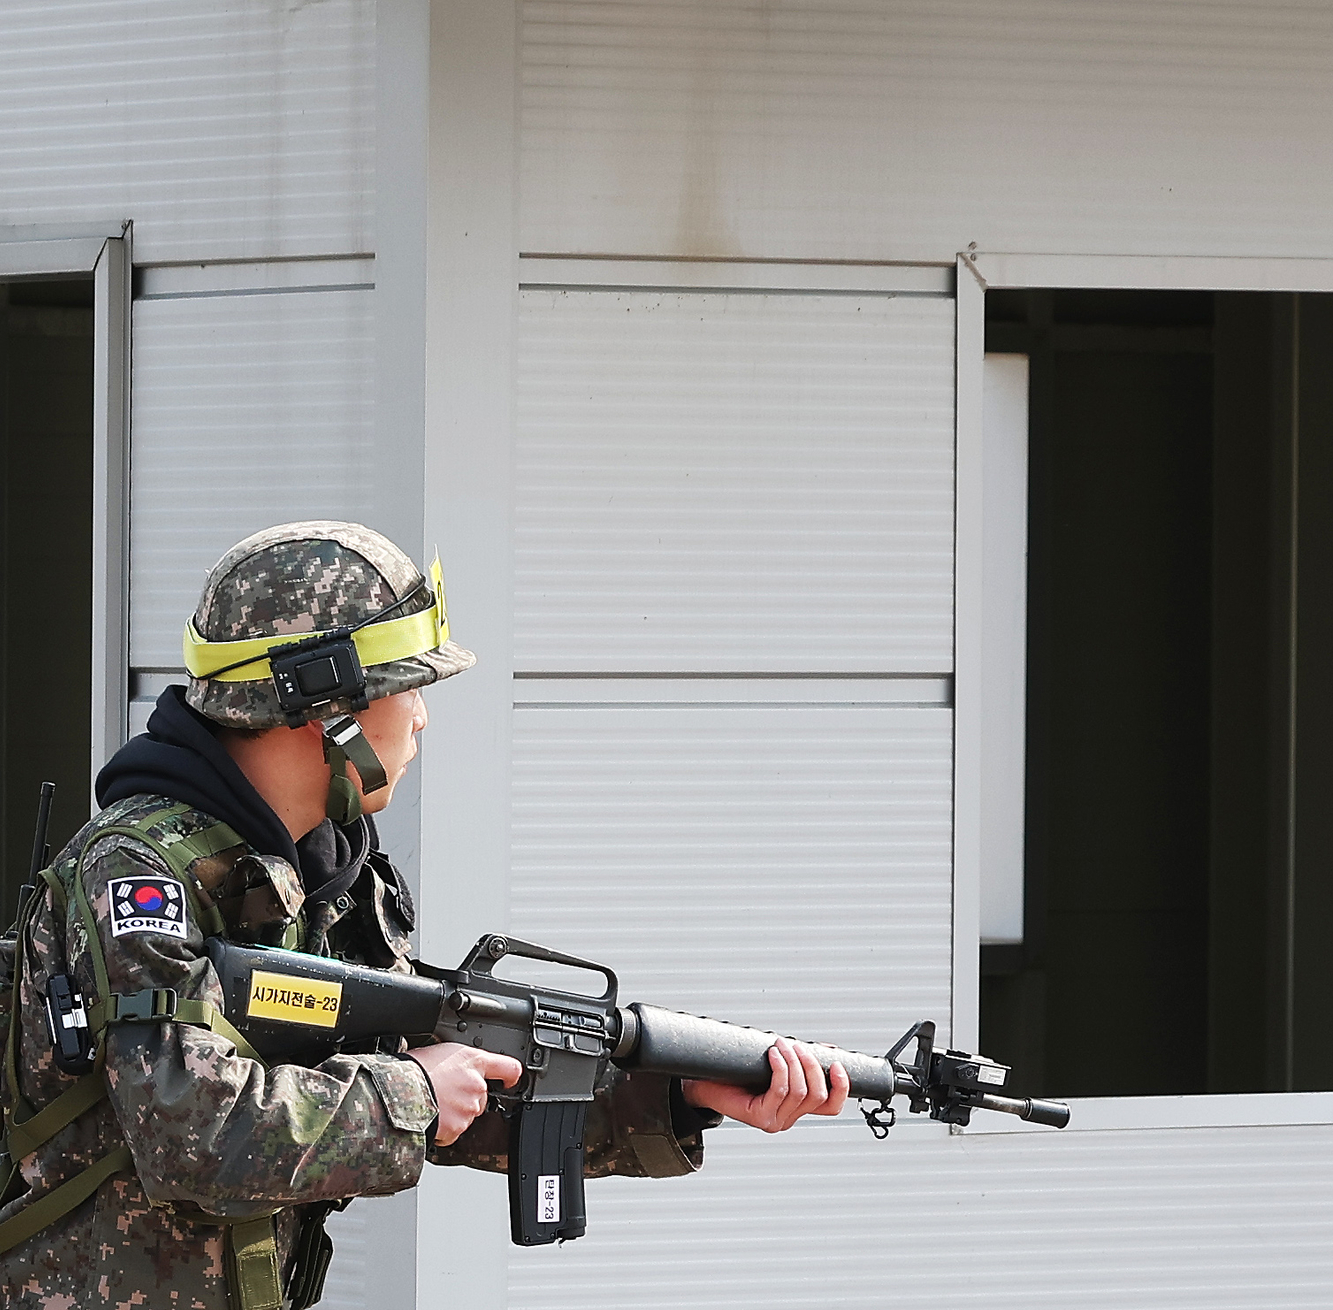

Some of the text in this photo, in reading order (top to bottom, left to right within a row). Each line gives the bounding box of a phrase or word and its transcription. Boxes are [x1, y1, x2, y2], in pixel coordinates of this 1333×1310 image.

[117, 919, 181, 933] KOREA
[252, 985, 339, 1012] 시가지전술-23
[544, 1179, 555, 1220] 탄창-23
